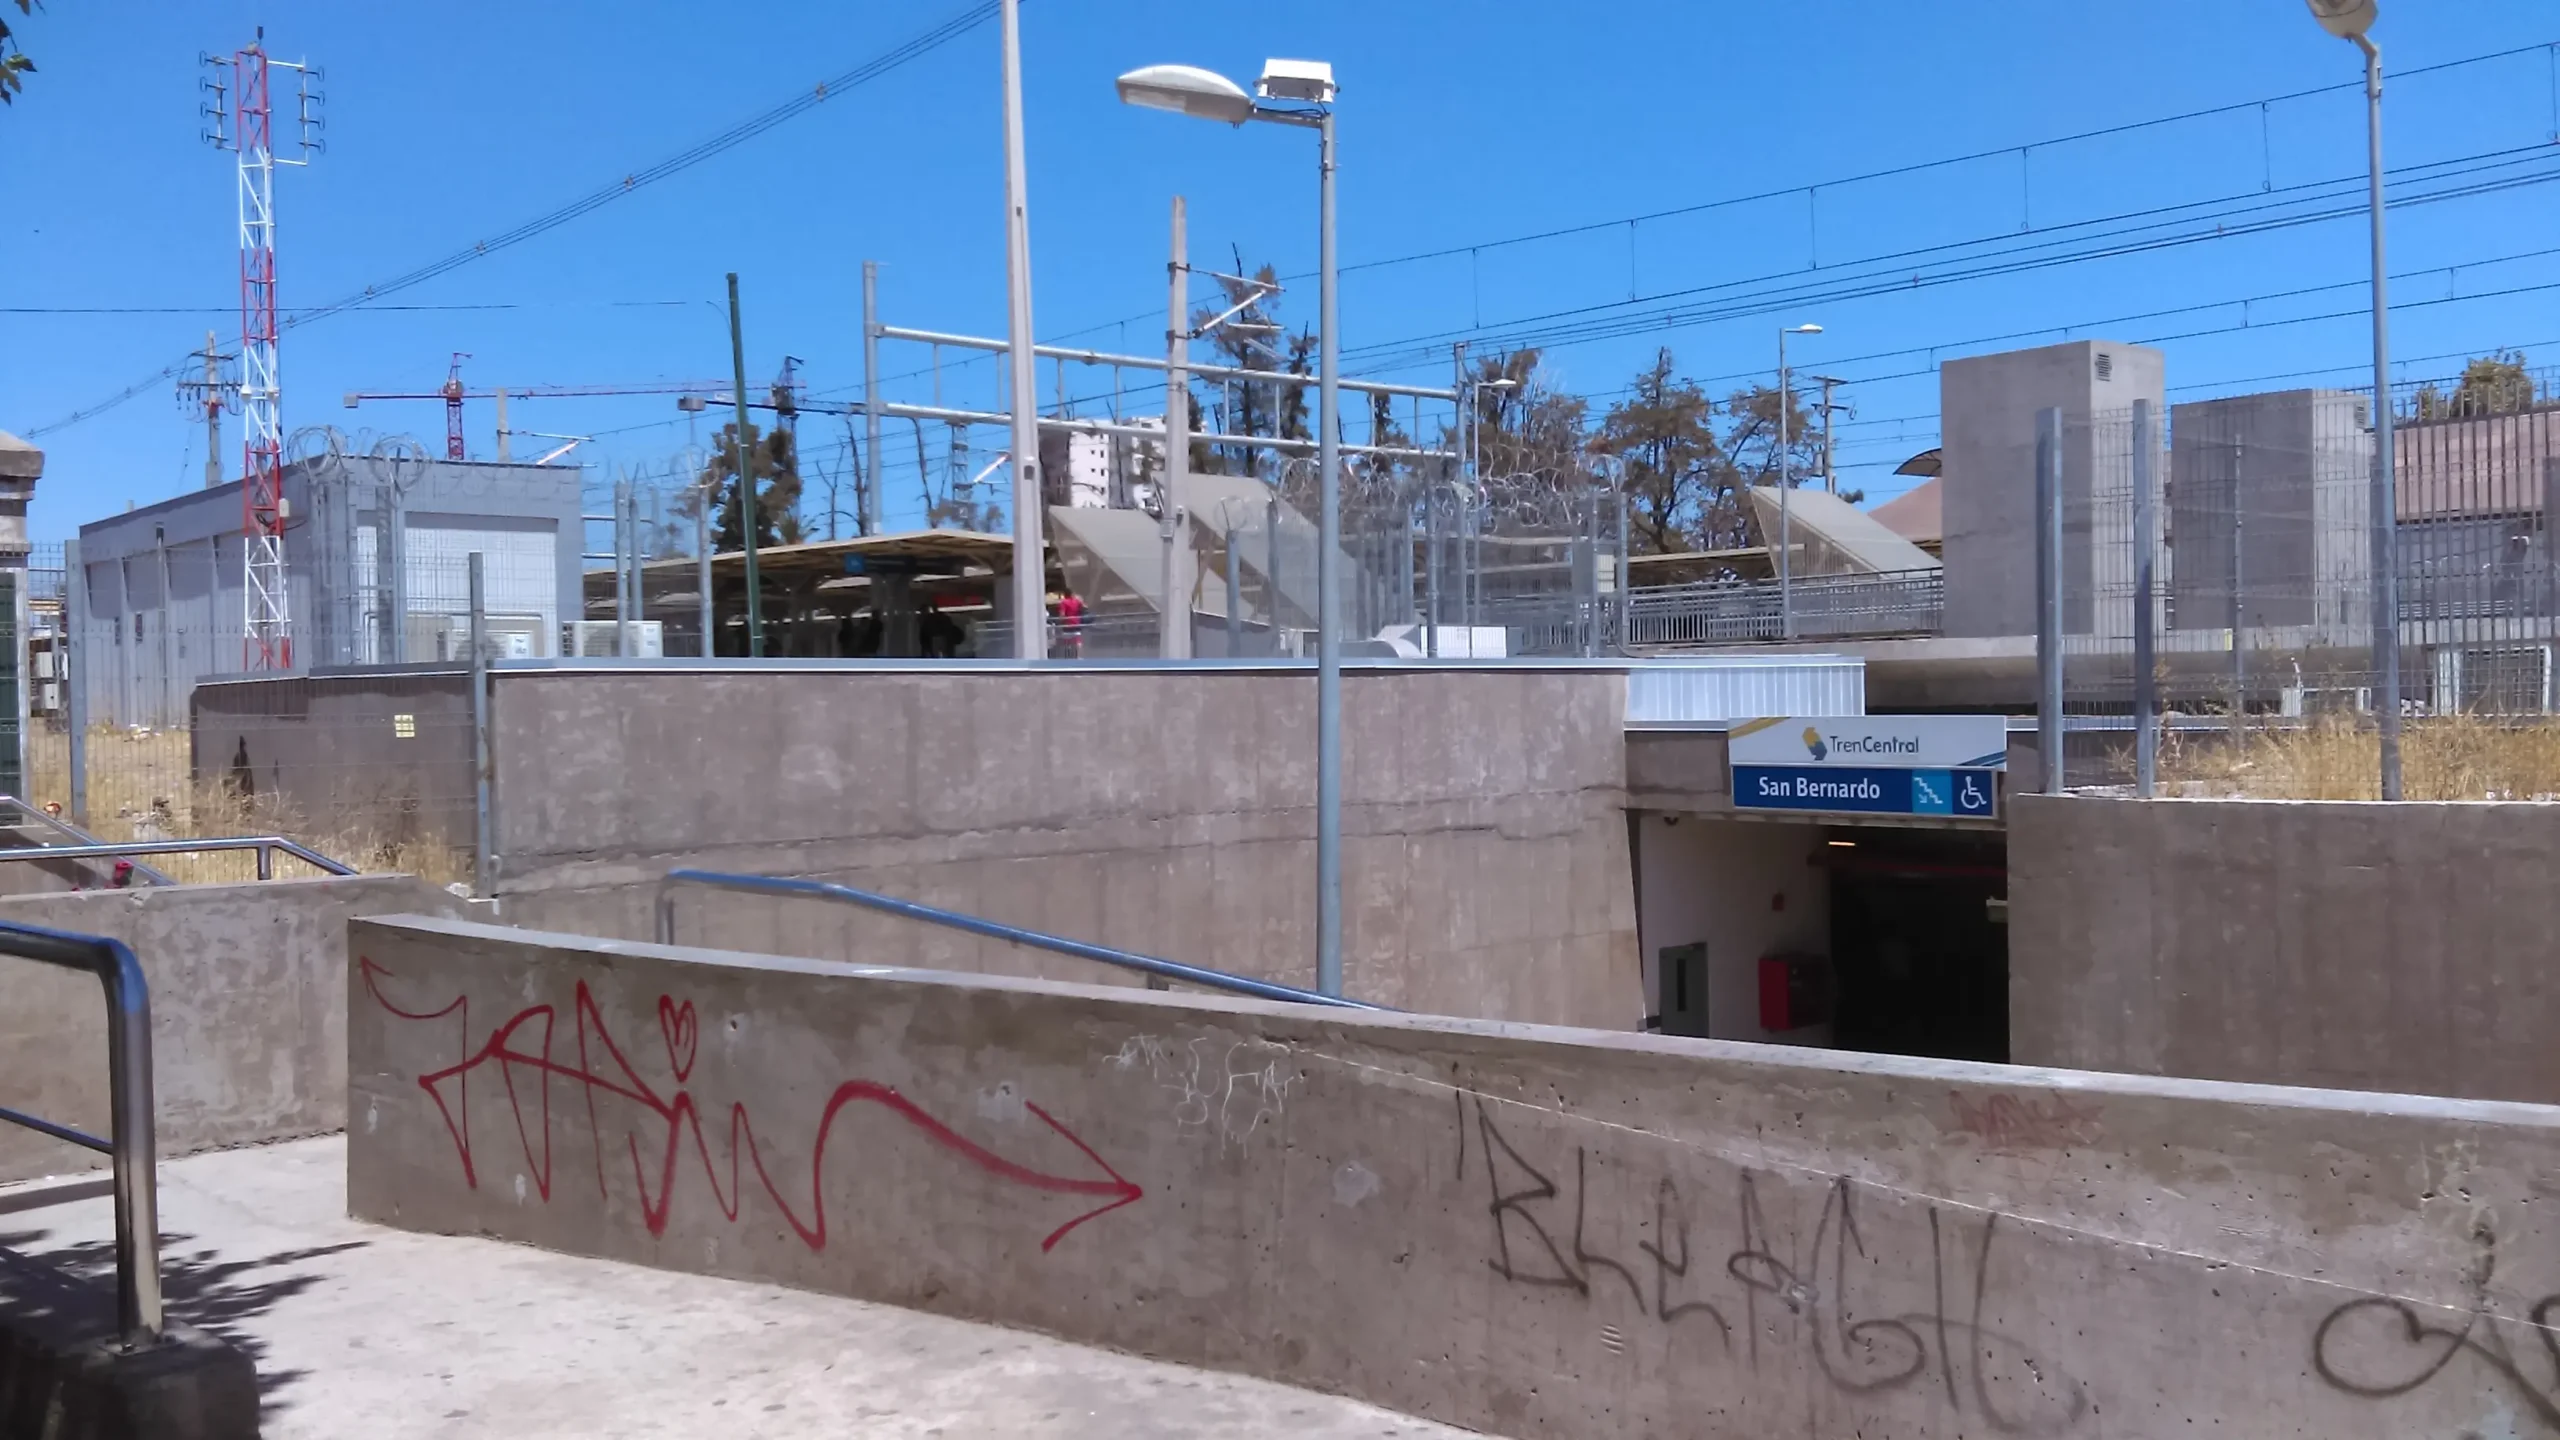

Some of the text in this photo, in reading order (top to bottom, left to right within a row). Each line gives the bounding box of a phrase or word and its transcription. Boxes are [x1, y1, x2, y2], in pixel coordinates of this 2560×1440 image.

[1829, 735, 1919, 754] TrenCentral
[1758, 776, 1880, 799] San Bernardo
